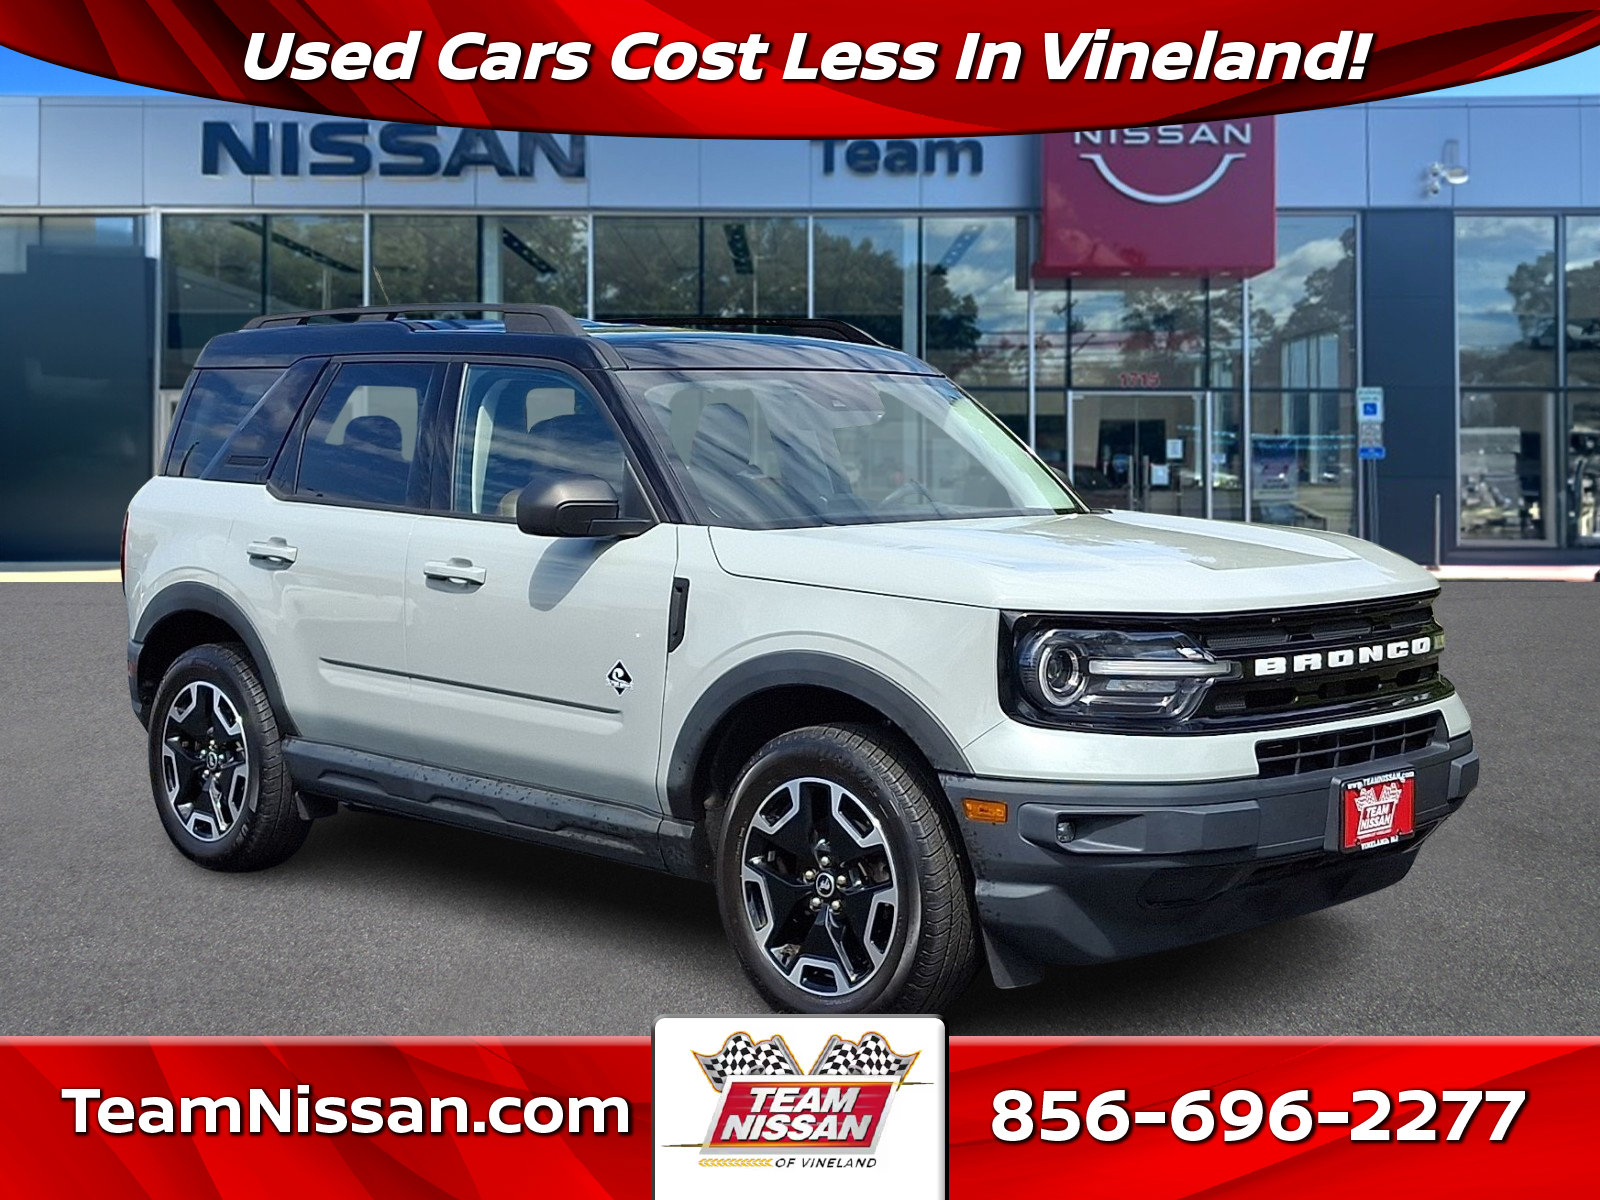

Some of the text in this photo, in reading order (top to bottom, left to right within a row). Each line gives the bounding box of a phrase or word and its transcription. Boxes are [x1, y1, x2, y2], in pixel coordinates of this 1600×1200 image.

[1074, 124, 1250, 145] NISSAN
[202, 121, 587, 178] NISSAN
[810, 139, 984, 176] Team
[1120, 372, 1160, 388] 1715
[1254, 636, 1431, 677] BRONCO
[1366, 803, 1390, 817] TEAM
[1360, 814, 1392, 830] NISSAN
